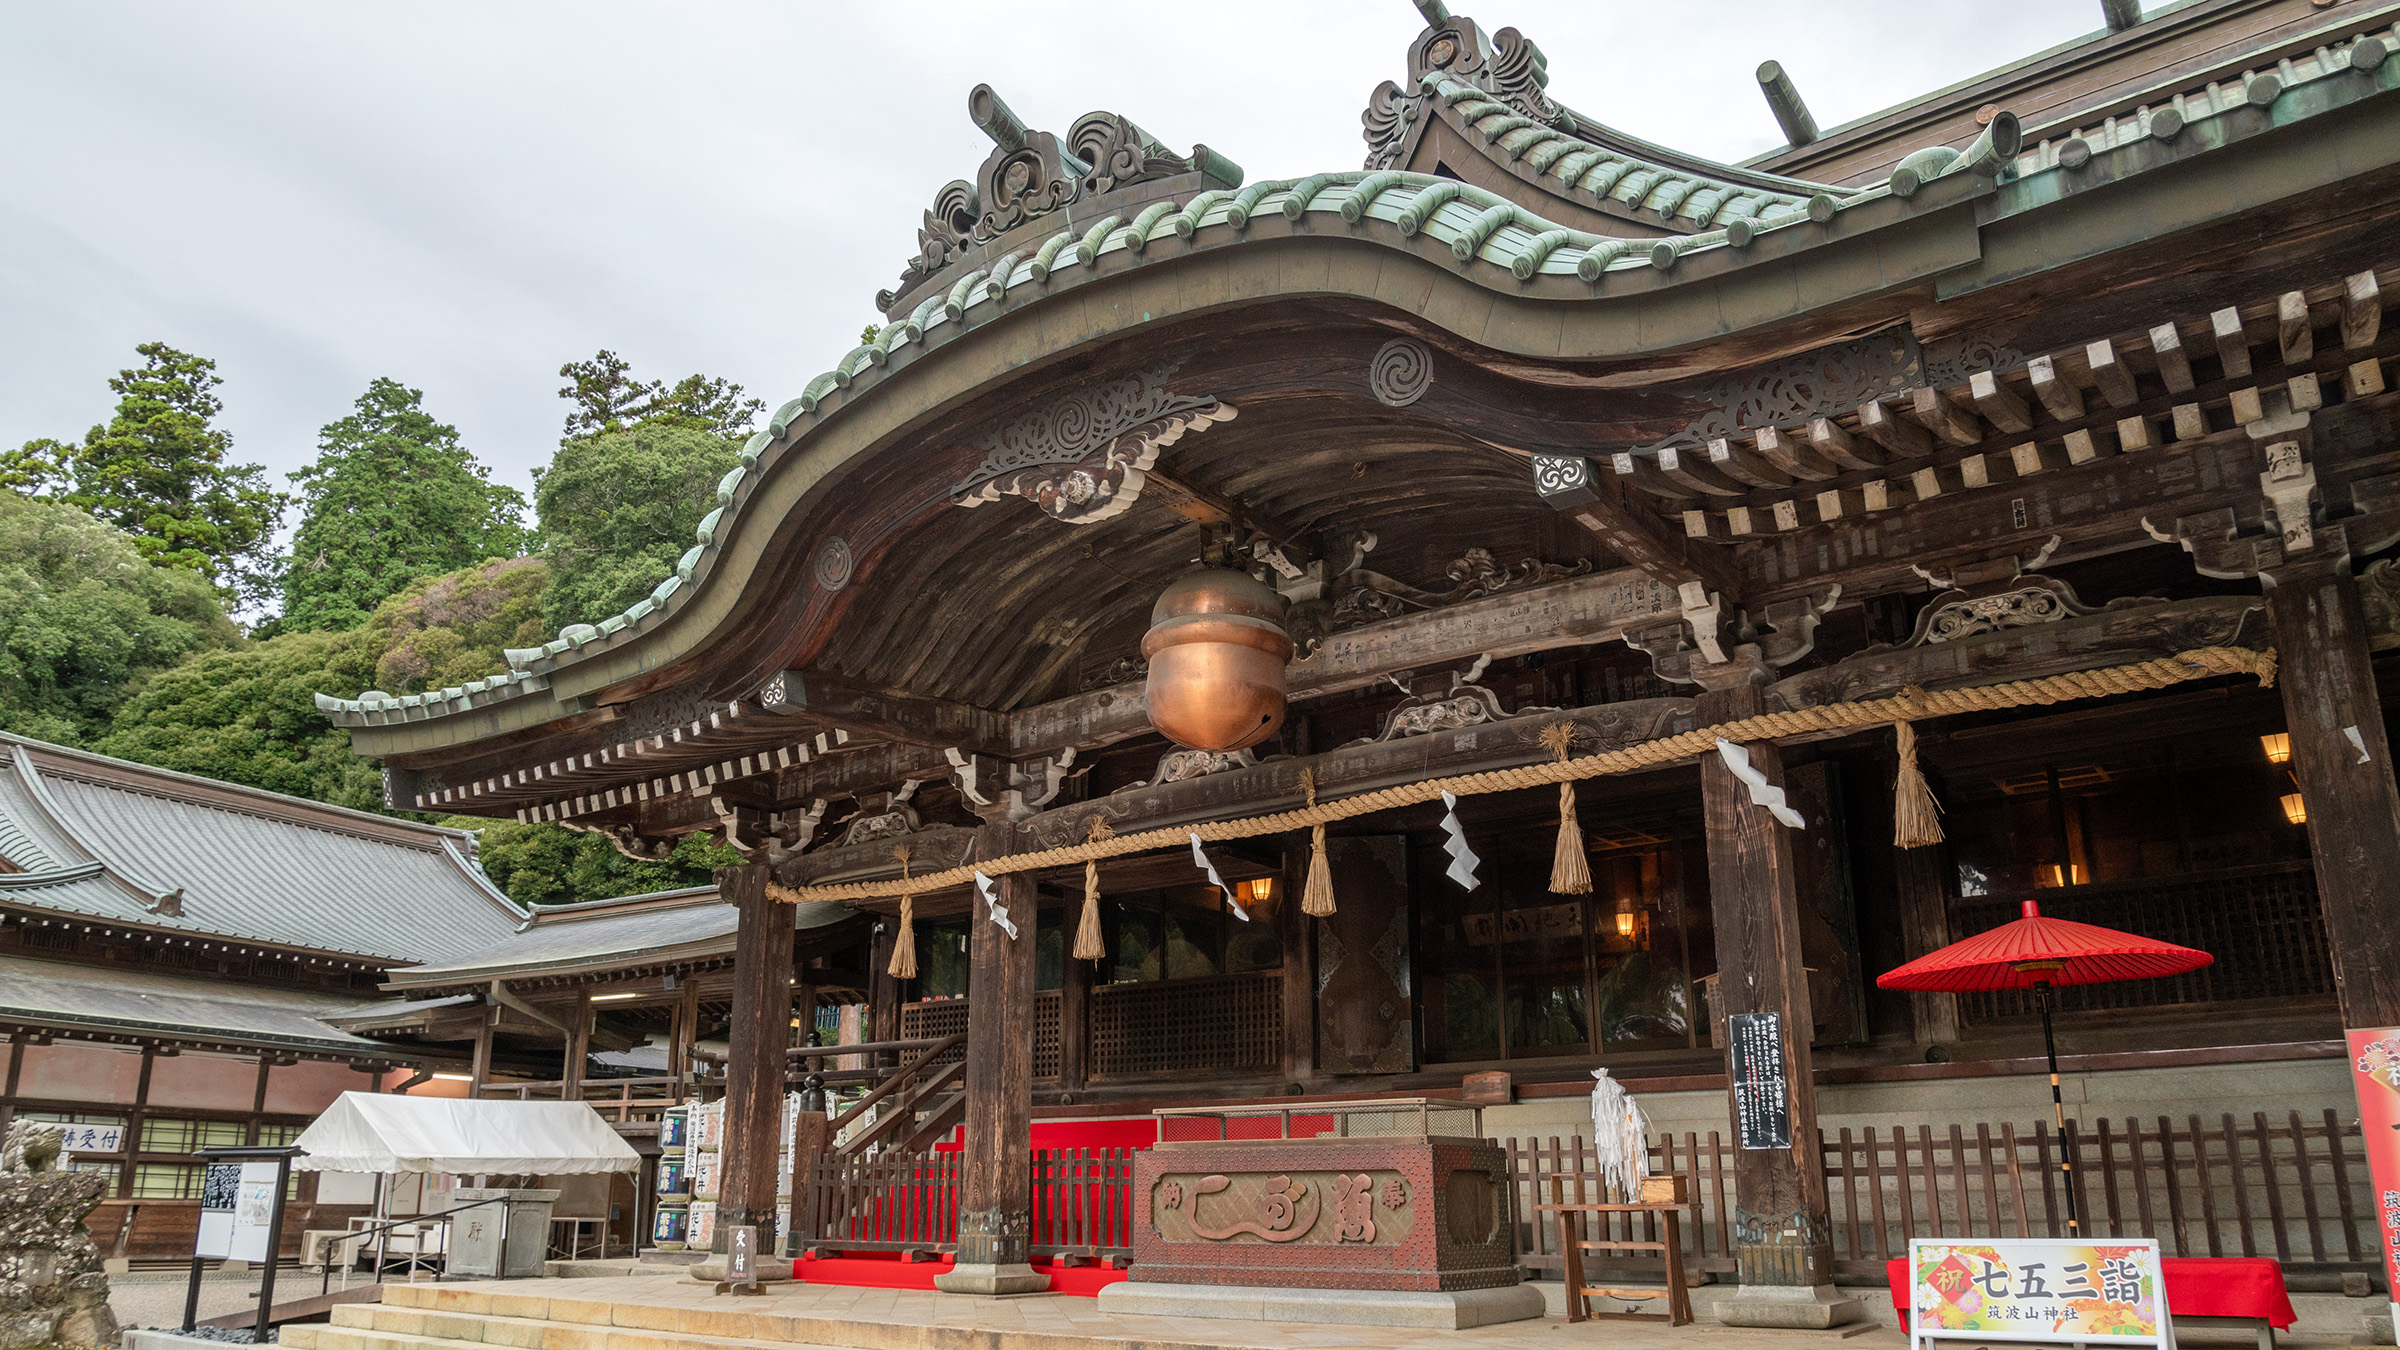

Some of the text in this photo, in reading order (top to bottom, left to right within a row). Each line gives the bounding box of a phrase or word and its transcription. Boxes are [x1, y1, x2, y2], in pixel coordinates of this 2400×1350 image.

[735, 1229, 746, 1272] 受付
[1936, 1258, 2143, 1305] 祝 七五三詣
[1987, 1305, 2079, 1322] 筑波山神社
